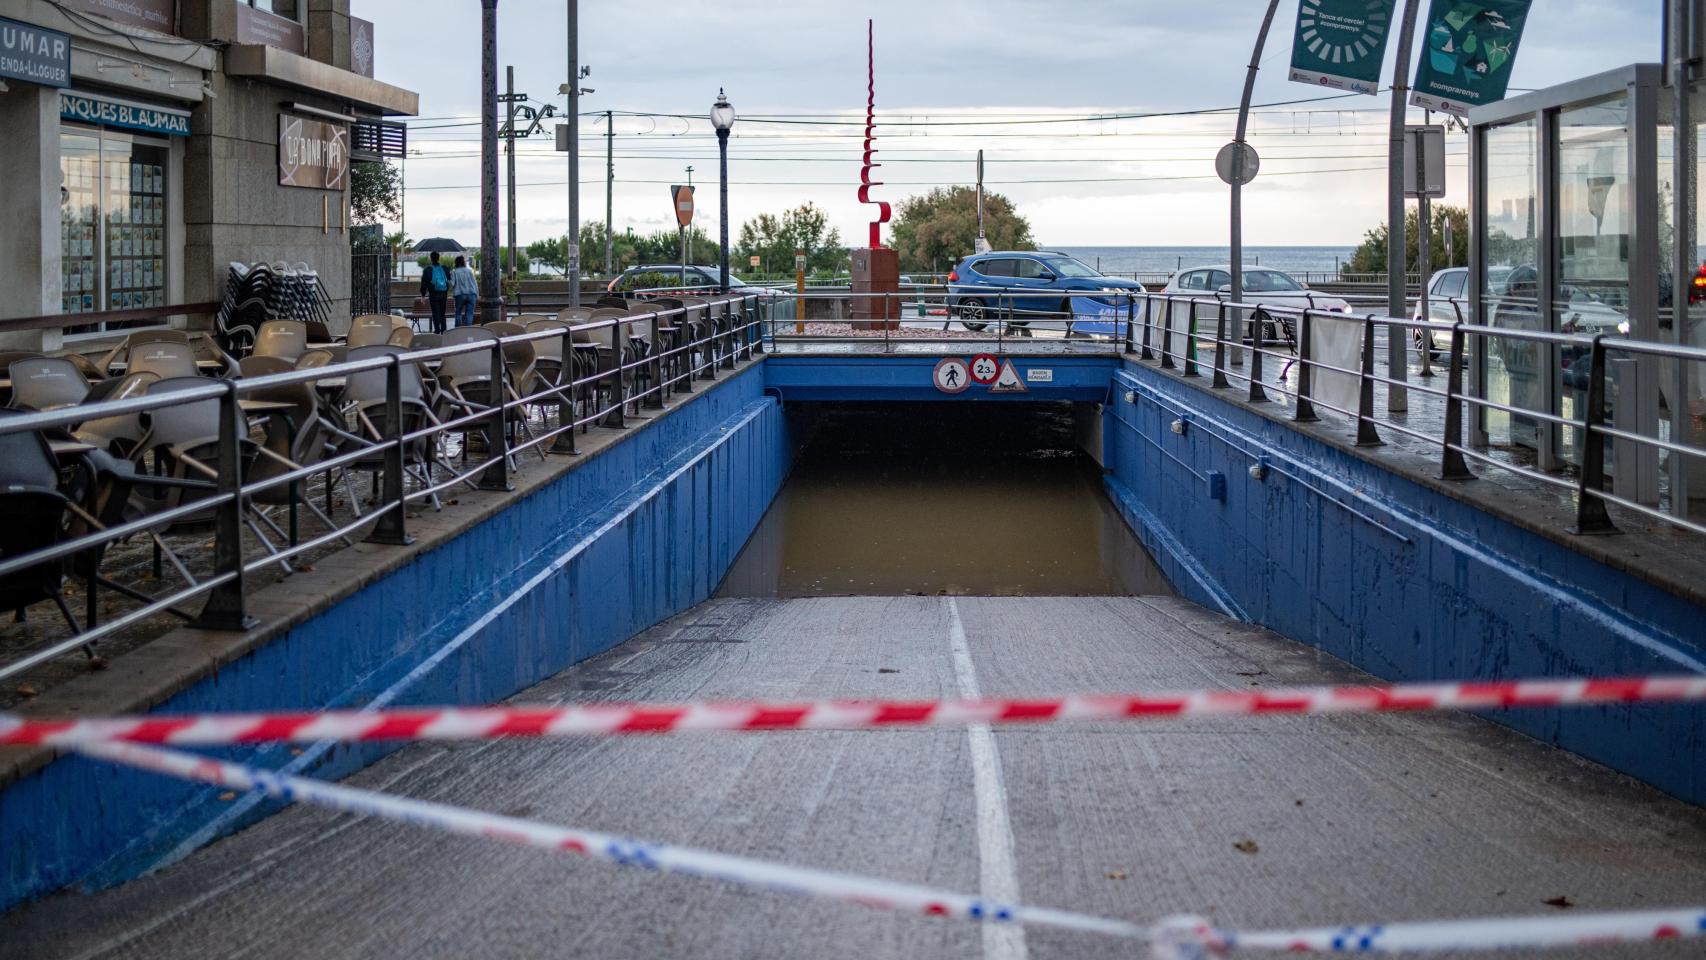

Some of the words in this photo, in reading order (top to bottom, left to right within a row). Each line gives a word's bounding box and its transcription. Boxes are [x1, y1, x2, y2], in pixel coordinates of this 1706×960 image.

[1319, 12, 1336, 21] Tanca
[3, 27, 65, 60] UMAR
[119, 106, 188, 132] BLAUMAR
[300, 138, 321, 167] BONA
